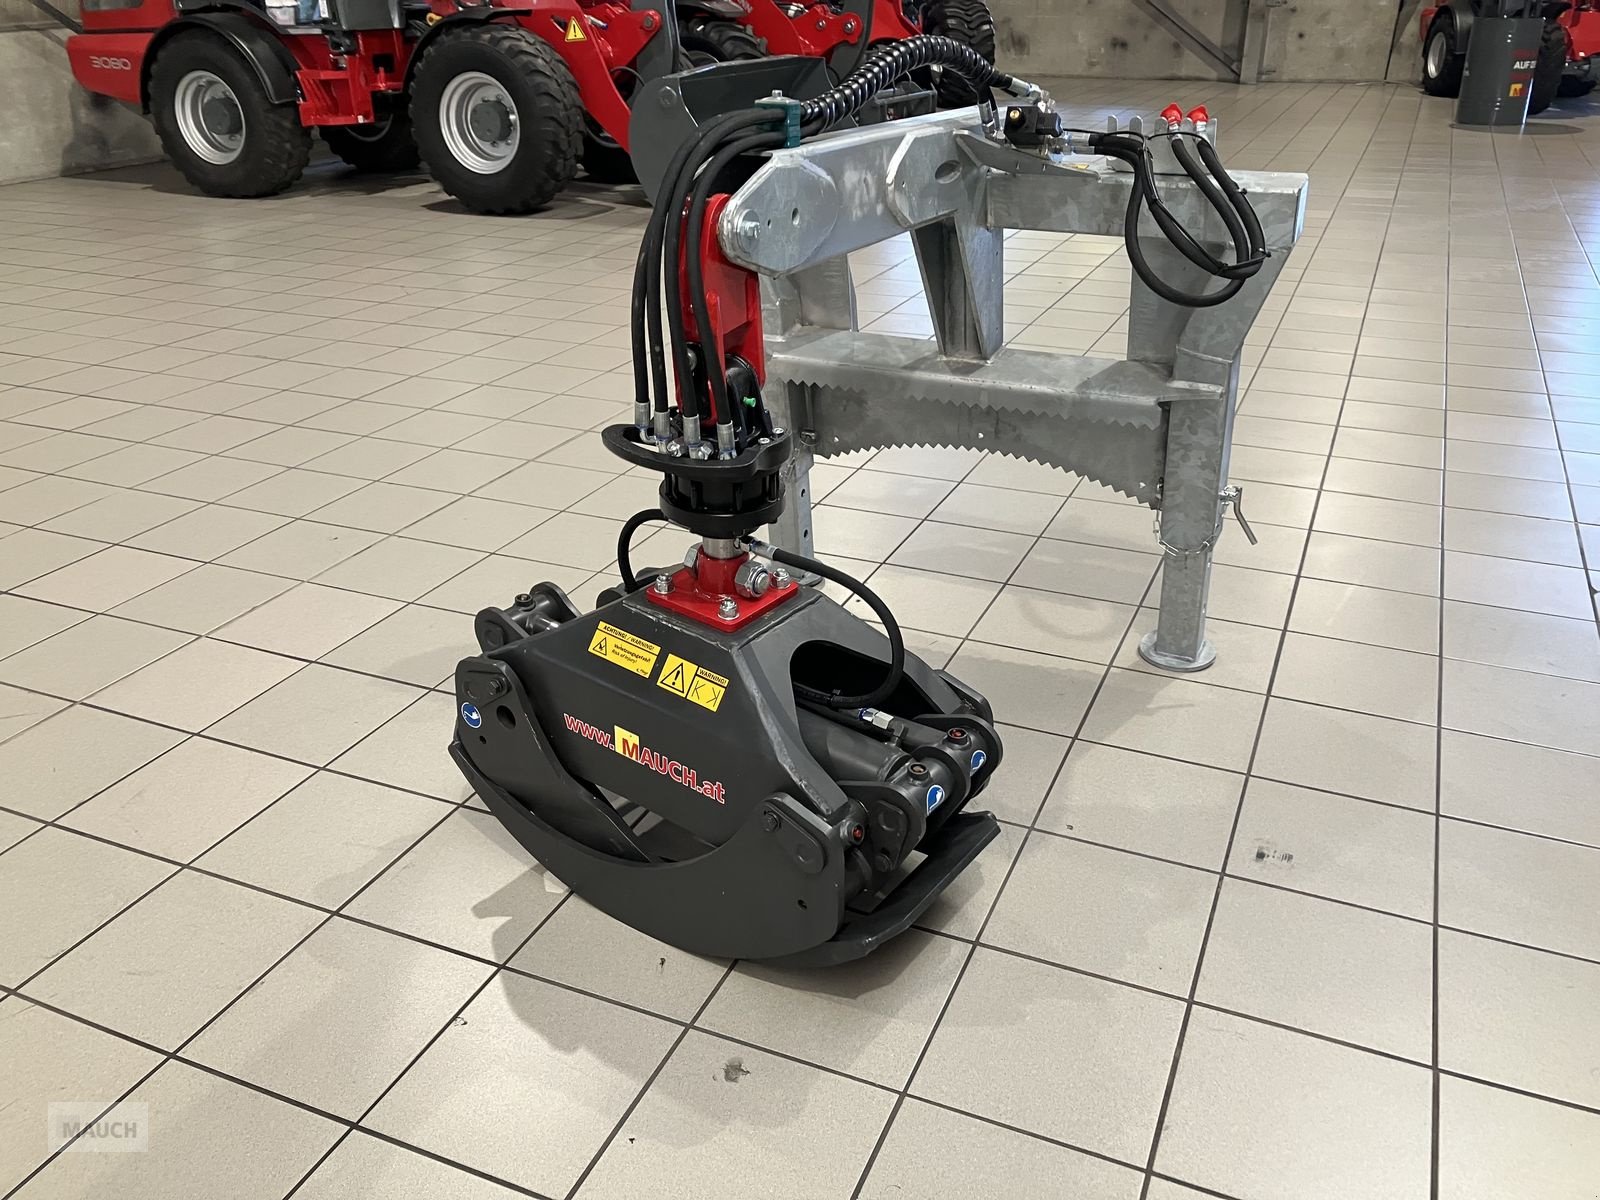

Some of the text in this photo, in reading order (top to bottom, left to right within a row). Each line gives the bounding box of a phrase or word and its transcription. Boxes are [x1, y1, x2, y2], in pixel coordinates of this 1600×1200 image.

[89, 56, 131, 70] 3080
[630, 637, 655, 651] WARNING!
[699, 669, 727, 685] WARNING!
